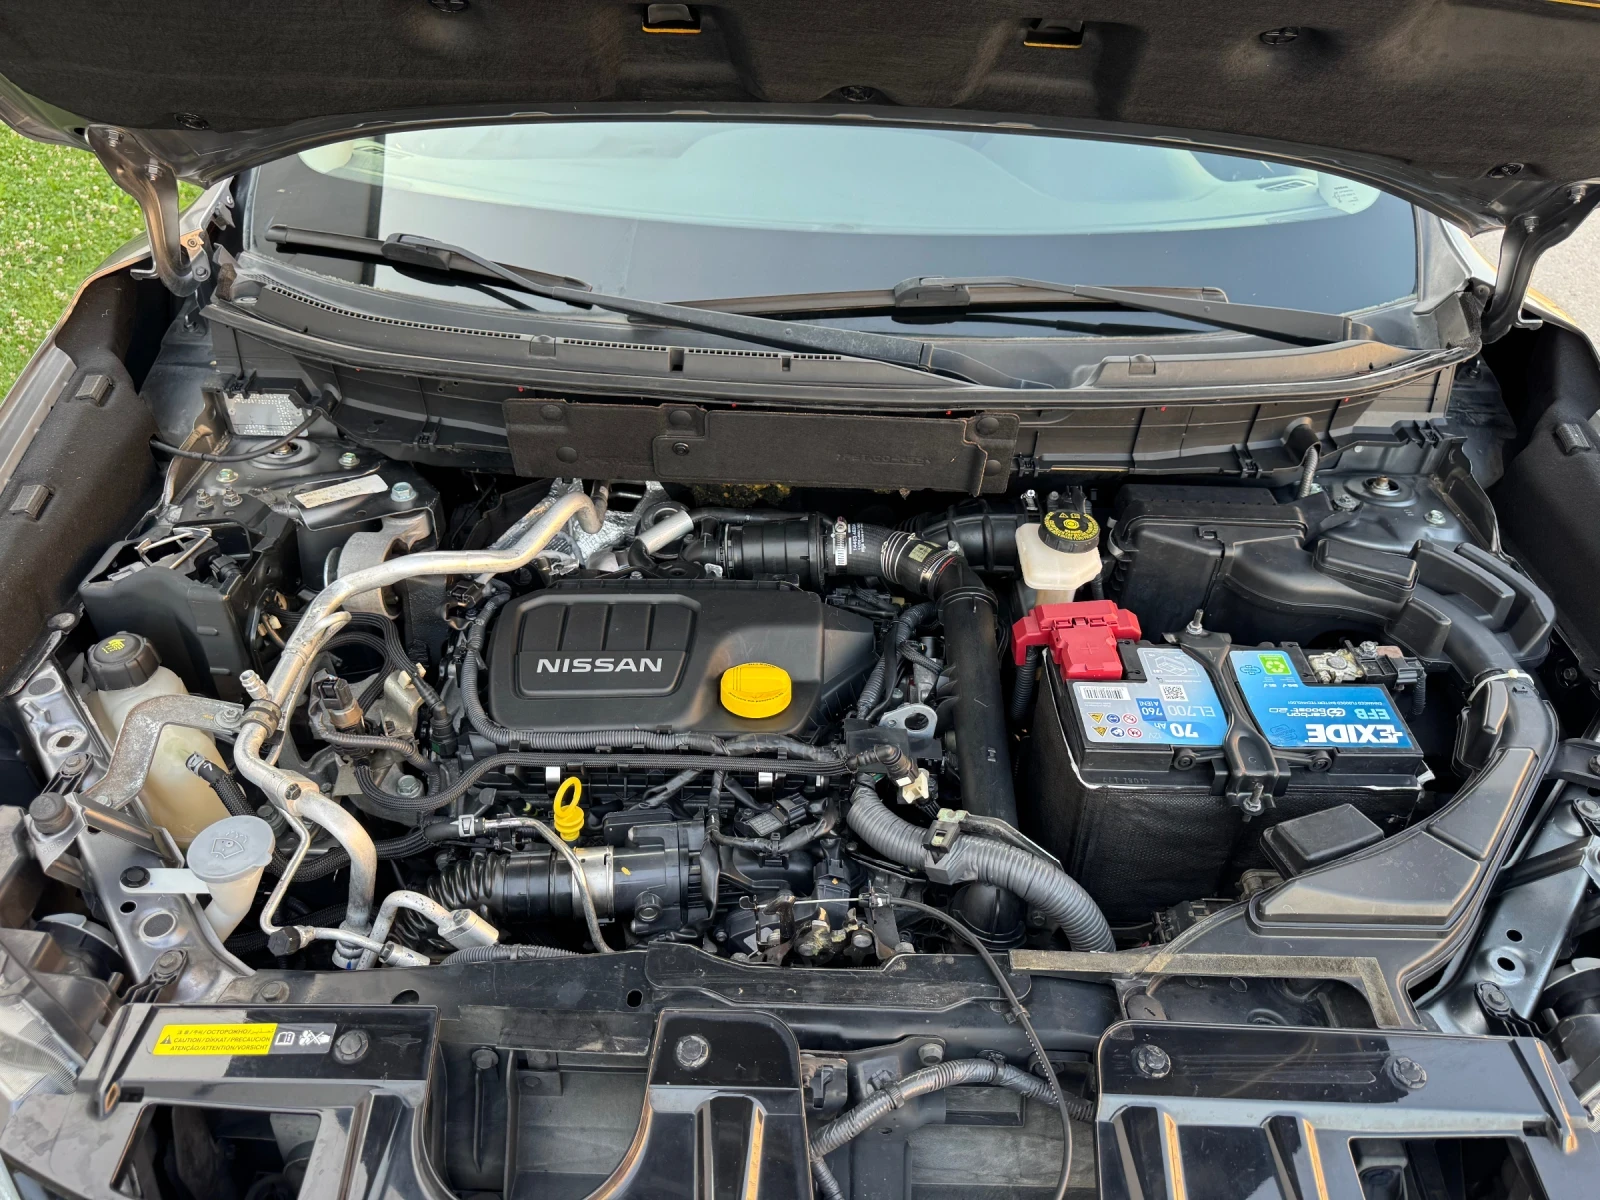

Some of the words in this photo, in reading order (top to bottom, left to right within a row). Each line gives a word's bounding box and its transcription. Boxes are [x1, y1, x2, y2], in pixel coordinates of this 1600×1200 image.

[536, 657, 663, 674] NISSAN
[1141, 707, 1163, 716] 760
[1167, 704, 1216, 718] EL700
[1353, 708, 1391, 720] EFB
[1148, 732, 1162, 740] 12V
[1169, 722, 1200, 738] 70
[1305, 723, 1403, 744] EXIDE
